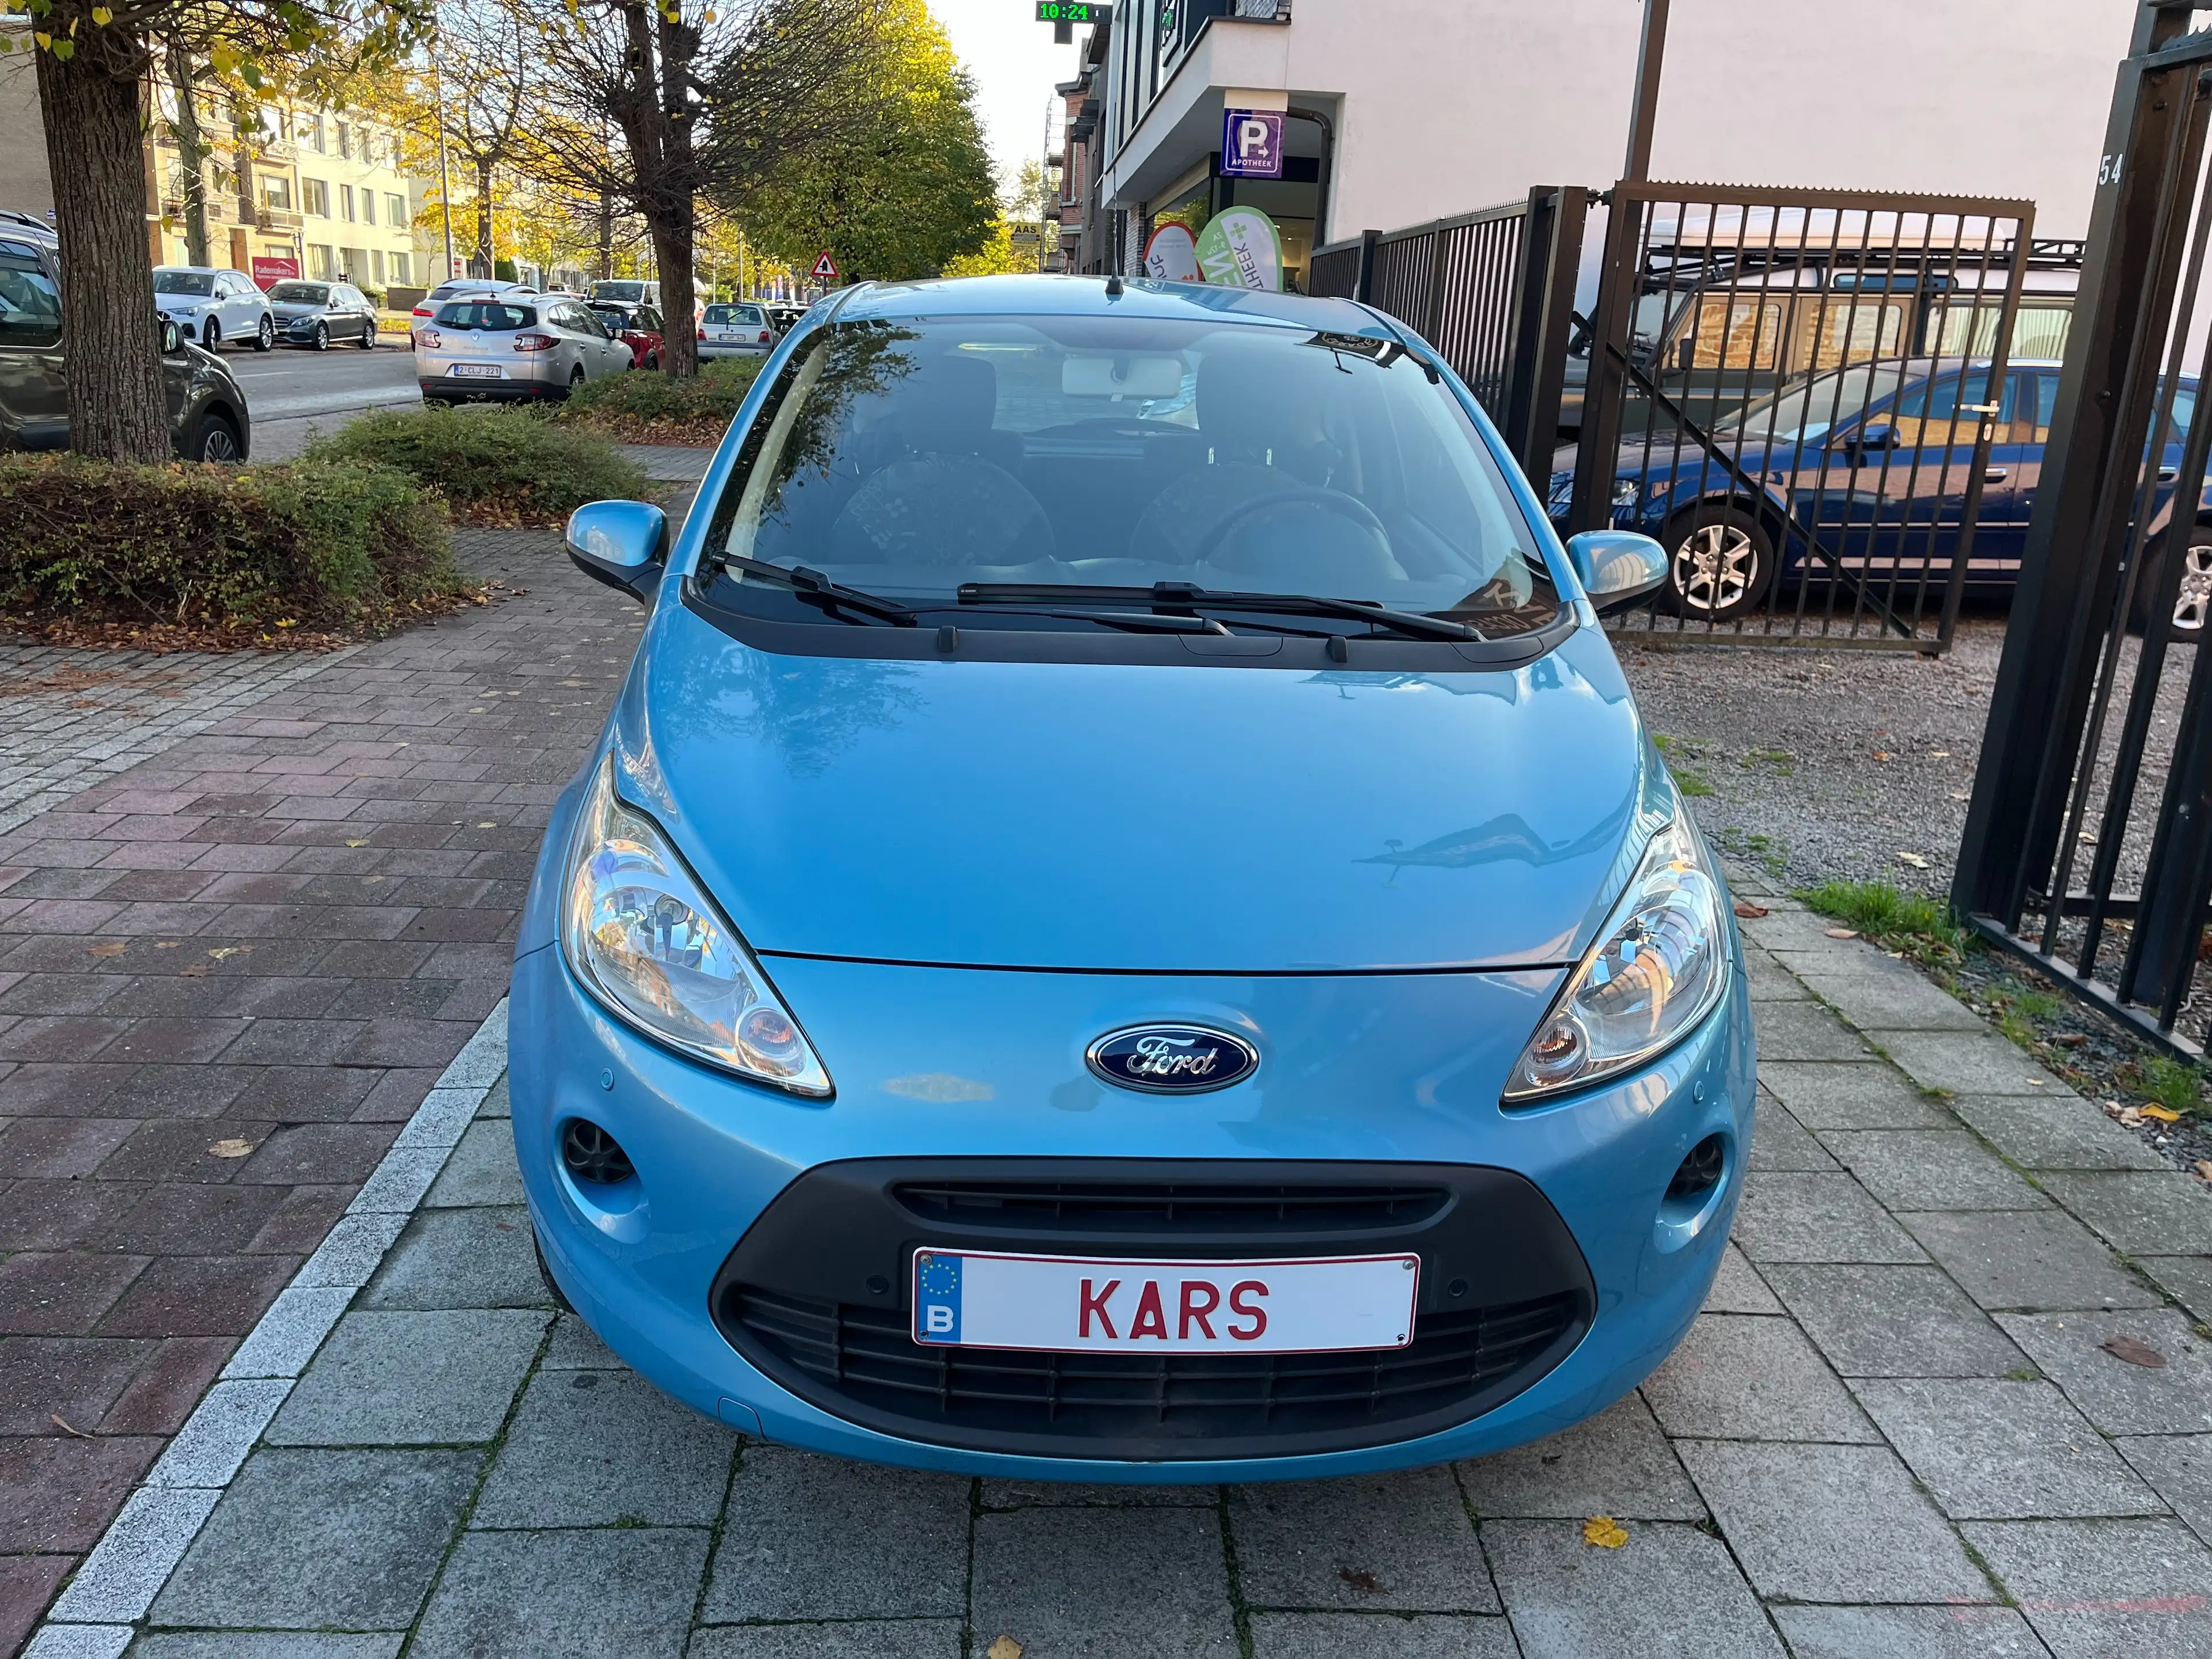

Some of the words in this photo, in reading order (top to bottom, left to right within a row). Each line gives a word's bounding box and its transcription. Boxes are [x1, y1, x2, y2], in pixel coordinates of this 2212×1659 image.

[1040, 3, 1088, 20] 10:24
[1240, 120, 1268, 157] P
[1232, 158, 1272, 167] APOTHEEK
[2099, 153, 2123, 185] 54
[1014, 225, 1037, 233] AAS
[1127, 1036, 1219, 1076] Ford
[927, 1305, 954, 1332] B
[1078, 1278, 1270, 1341] KARS
